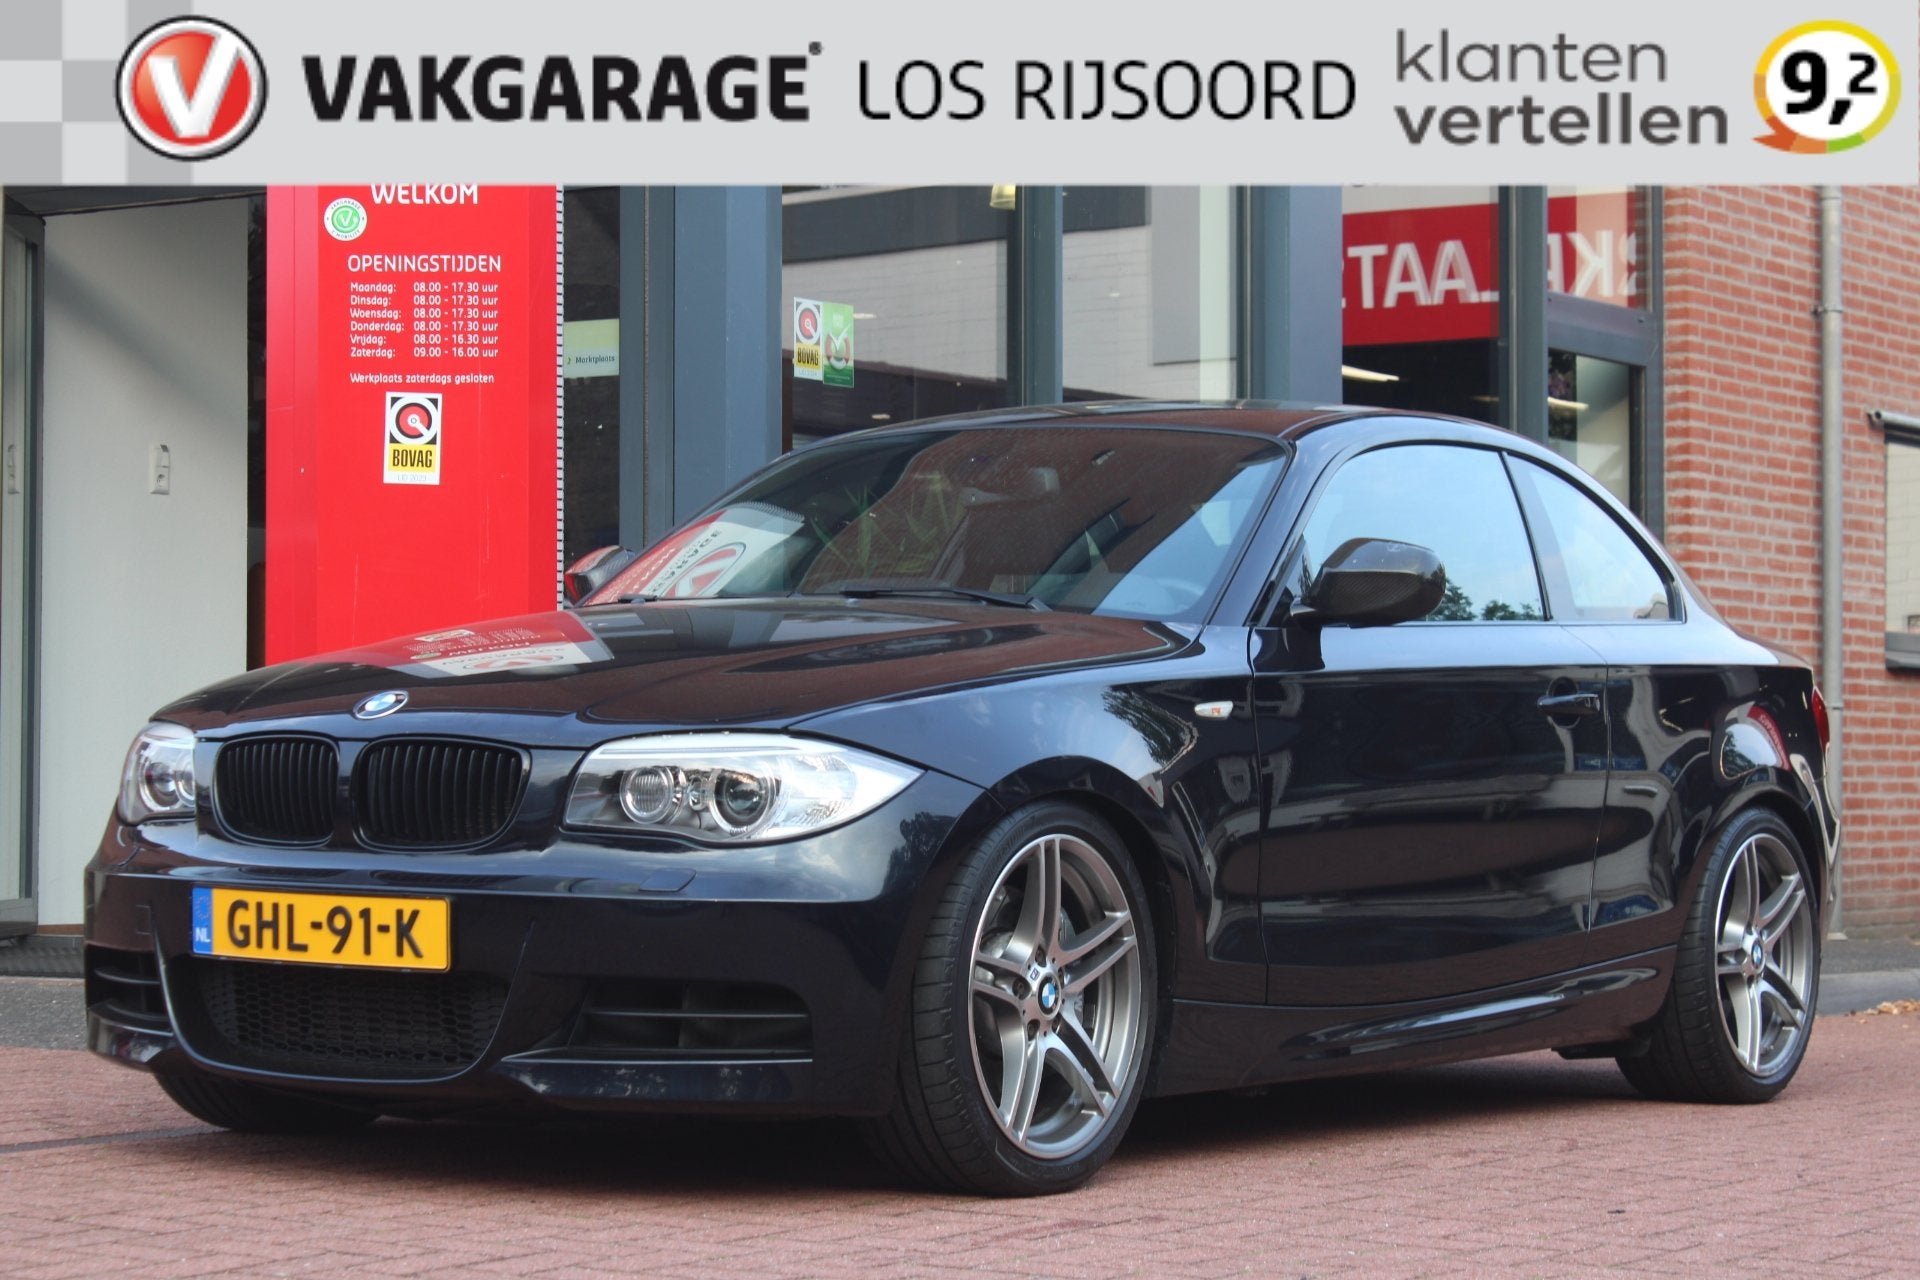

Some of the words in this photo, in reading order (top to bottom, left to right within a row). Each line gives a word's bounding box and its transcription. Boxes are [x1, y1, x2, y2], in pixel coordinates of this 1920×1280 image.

[370, 185, 479, 205] WELKOM
[347, 254, 502, 273] OPENINGSTIJDEN
[350, 281, 397, 294] Maandag:
[413, 282, 442, 293] 08.00
[482, 284, 499, 293] uur
[350, 294, 392, 307] Dinsdag:
[413, 295, 442, 306] 08.00
[482, 297, 499, 306] uur
[350, 307, 402, 320] Woensdag:
[413, 308, 442, 319] 08.00
[482, 310, 499, 319] uur
[350, 320, 405, 333] Donderdag:
[413, 321, 442, 332] 08.00
[482, 323, 499, 332] uur
[350, 333, 387, 346] Vrijdag:
[413, 334, 442, 345] 08.00
[482, 336, 499, 345] uur
[350, 346, 396, 359] Zaterdag:
[413, 347, 442, 358] 09.00
[482, 349, 499, 358] uur
[797, 347, 819, 367] BOVAG
[350, 372, 403, 385] Werkplaats
[405, 373, 452, 385] zaterdags
[454, 373, 495, 385] gesloten
[392, 449, 433, 468] BOVAG
[195, 927, 211, 943] NL
[227, 899, 424, 959] GHL-91-K
